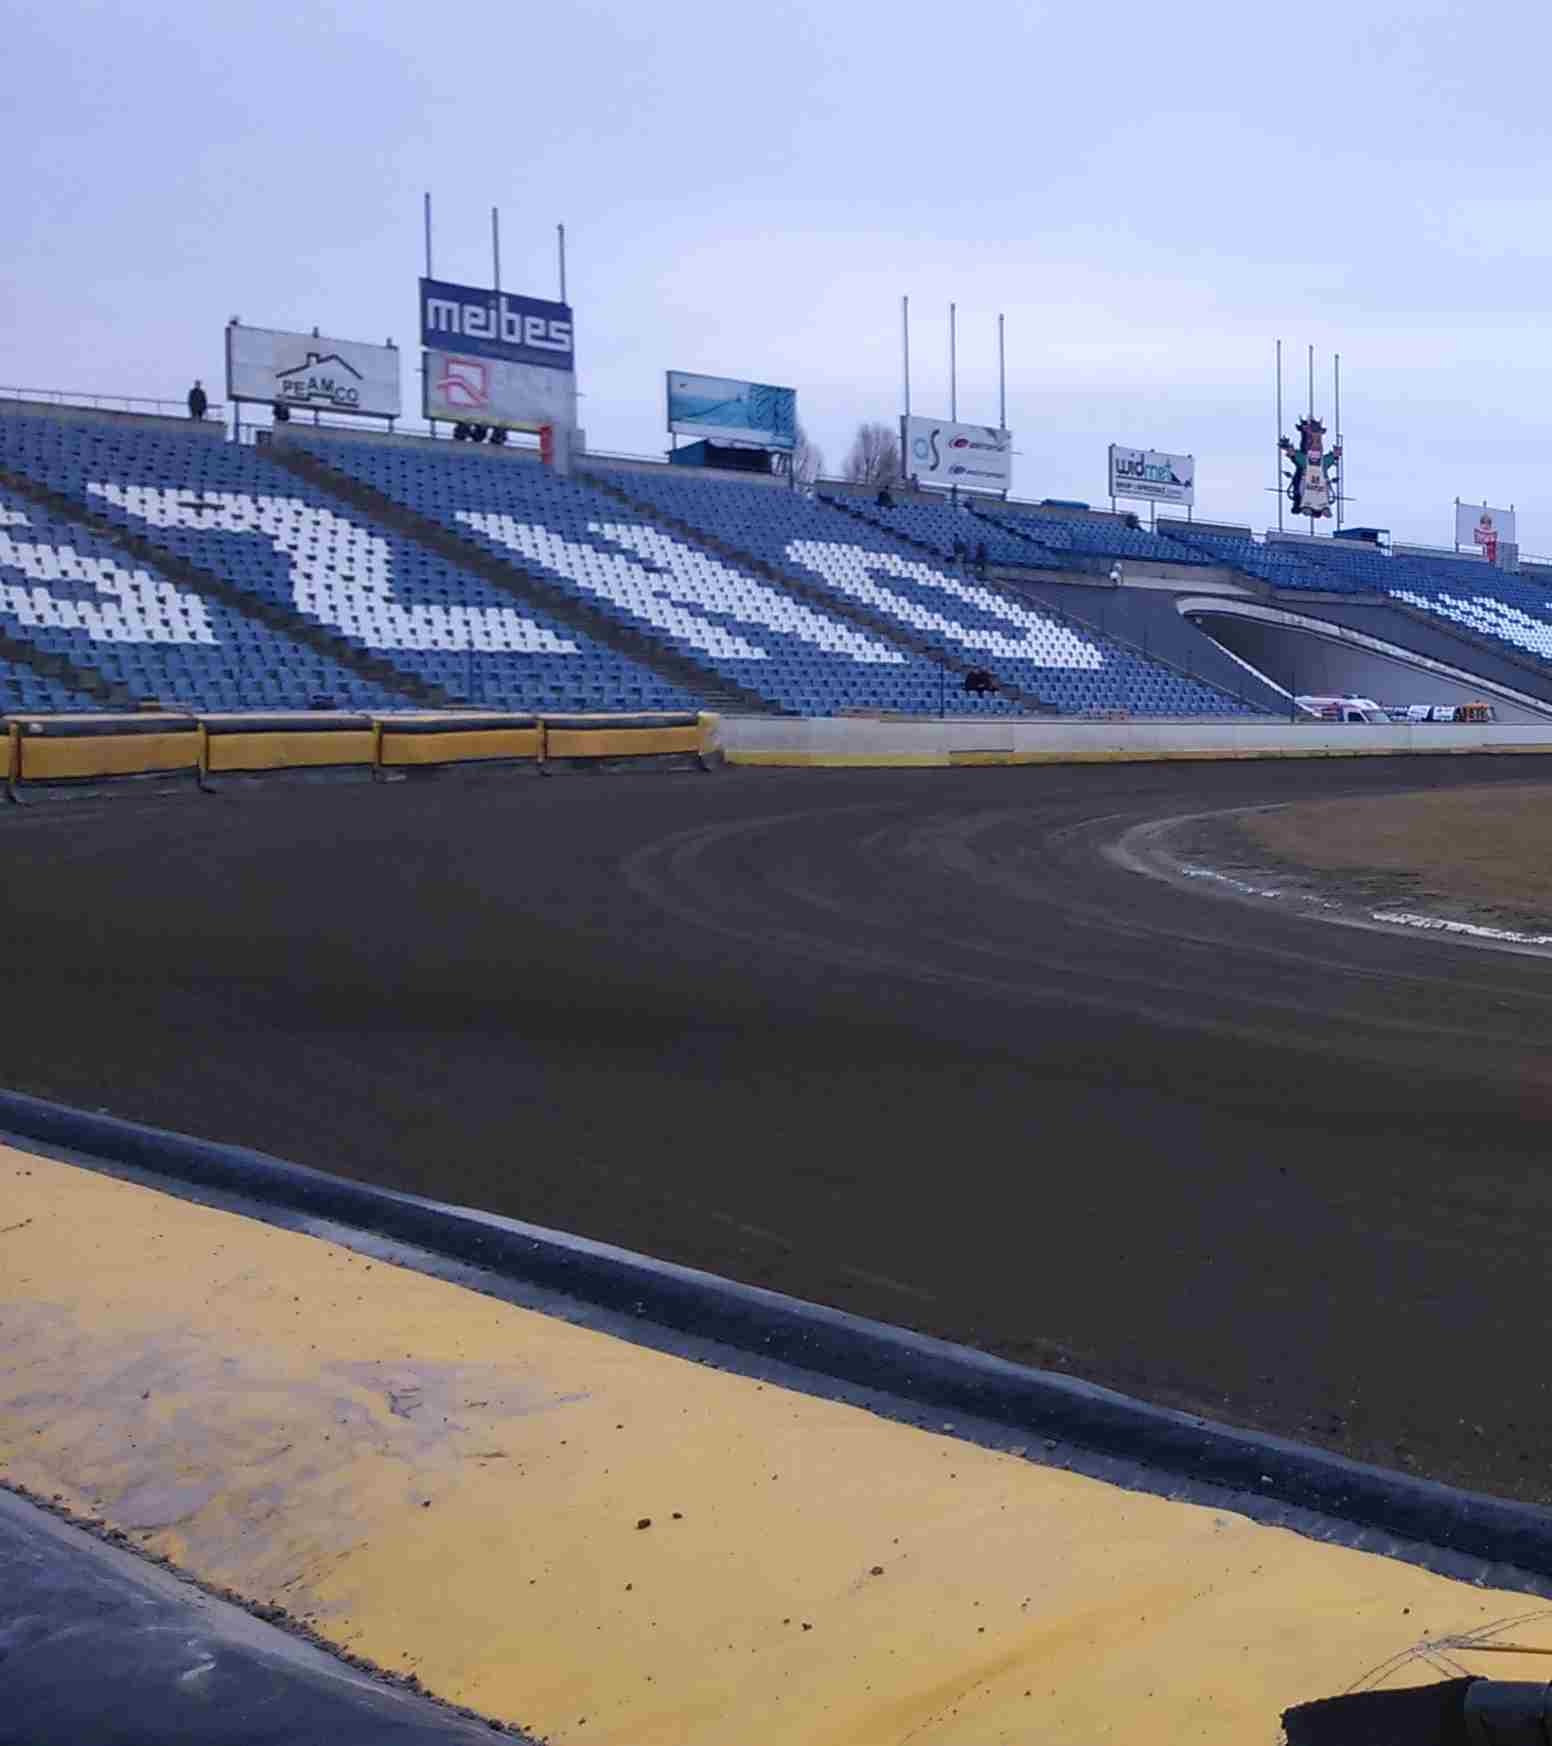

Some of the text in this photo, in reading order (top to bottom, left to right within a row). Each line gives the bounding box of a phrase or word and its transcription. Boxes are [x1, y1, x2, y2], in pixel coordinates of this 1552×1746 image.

[427, 297, 572, 352] meibes
[281, 375, 360, 402] PEAMCO
[1115, 453, 1173, 481] widmet
